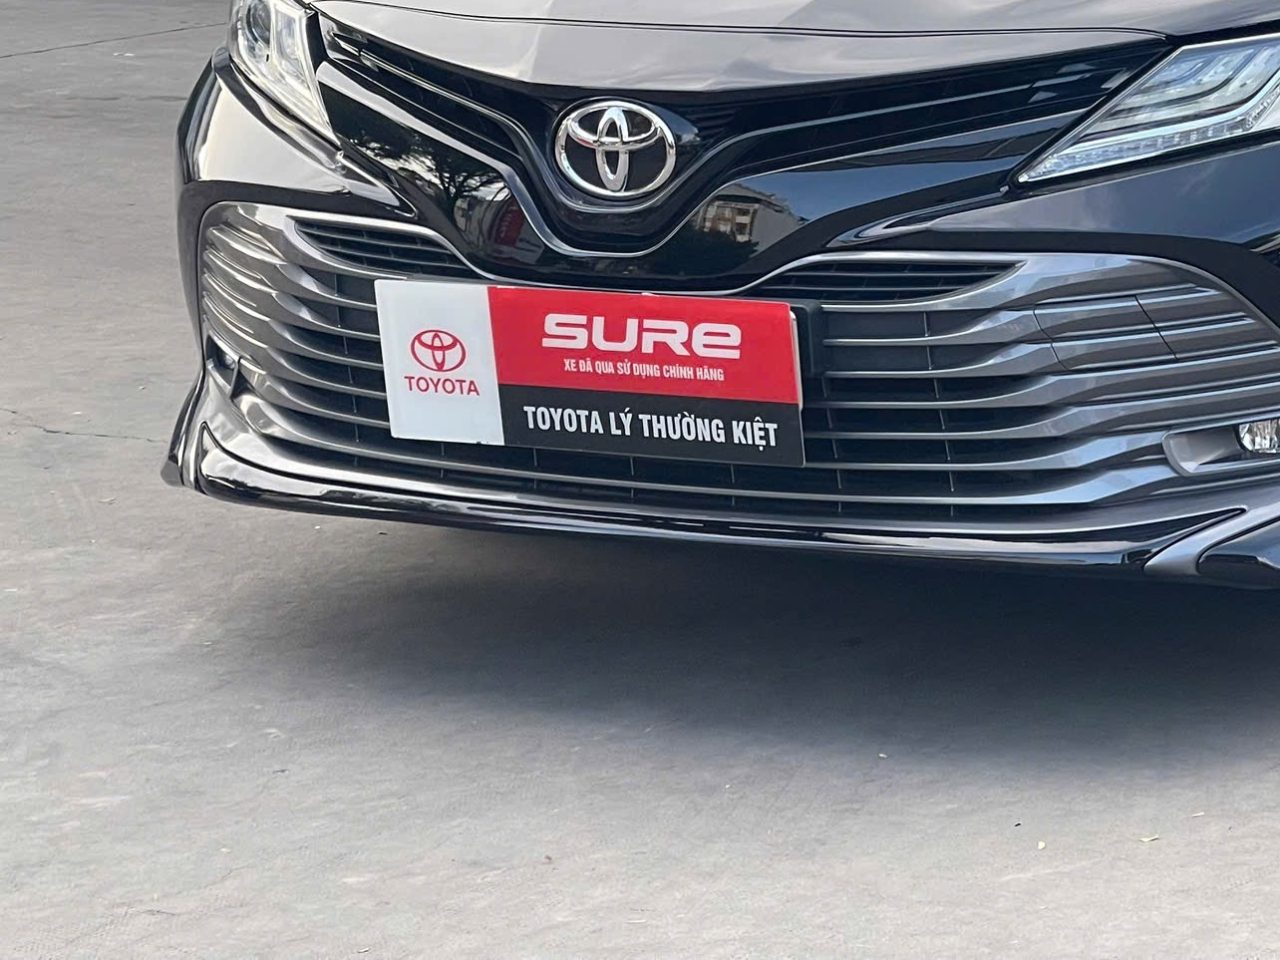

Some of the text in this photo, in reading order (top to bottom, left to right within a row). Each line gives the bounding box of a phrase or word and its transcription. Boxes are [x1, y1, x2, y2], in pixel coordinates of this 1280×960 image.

[563, 358, 577, 371] XE
[595, 361, 614, 374] QUA
[633, 363, 660, 379] DỤNG
[404, 375, 480, 396] TOYOTA
[523, 405, 779, 452] TOYOTA LÝ THƯỜNG KIỆT
